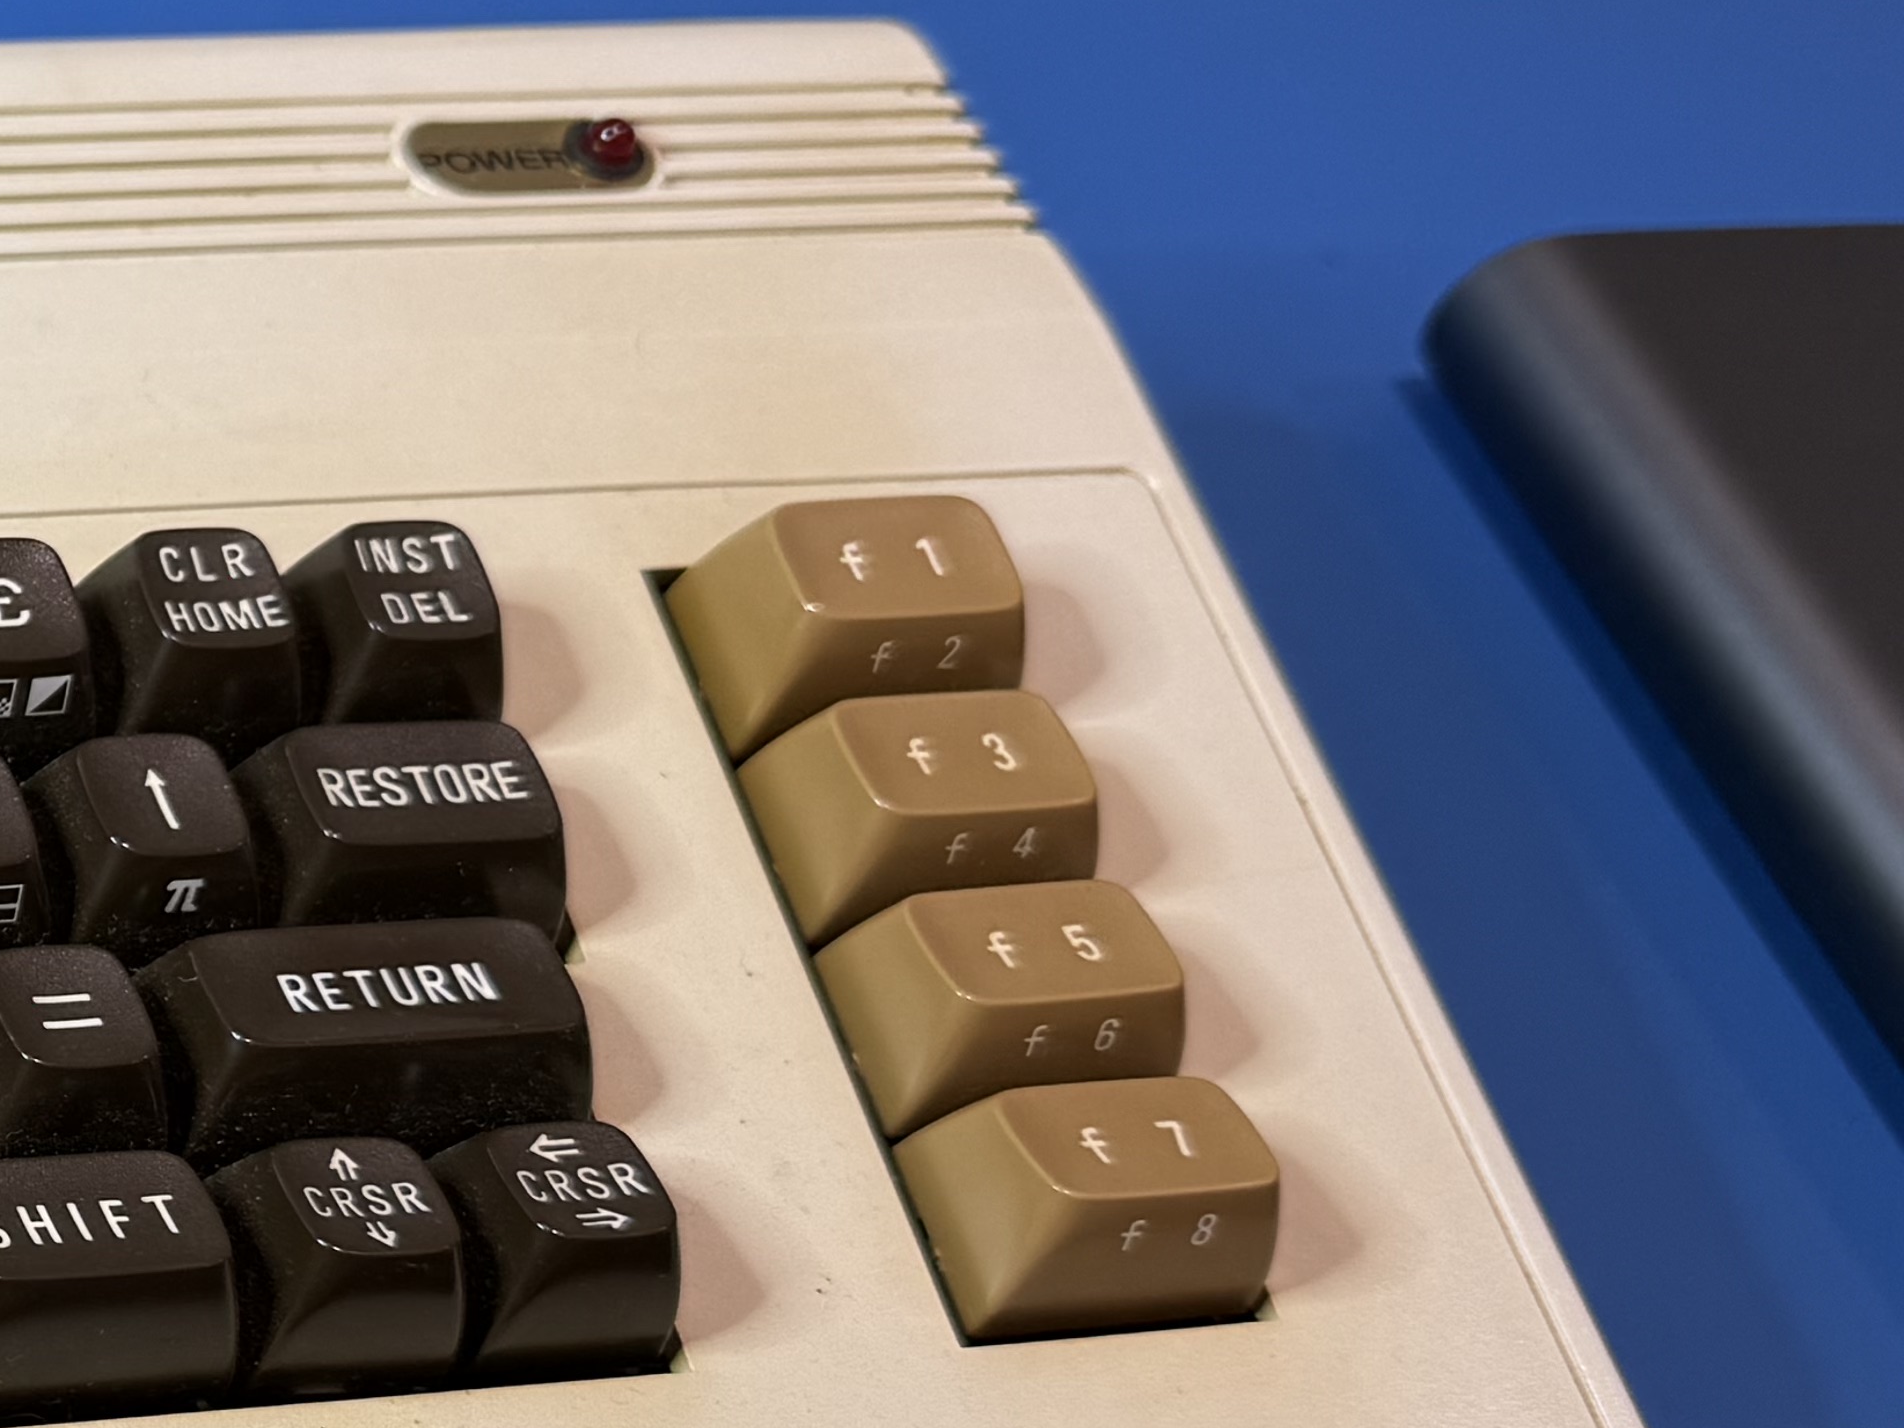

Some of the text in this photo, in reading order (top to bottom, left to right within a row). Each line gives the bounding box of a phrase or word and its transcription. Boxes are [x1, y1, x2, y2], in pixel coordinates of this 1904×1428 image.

[418, 149, 566, 174] POWER
[159, 542, 255, 582] CLR
[350, 532, 460, 574] INST
[164, 594, 289, 632] HOME
[380, 591, 470, 624] DEL
[316, 760, 529, 807] RESTORE
[276, 962, 499, 1013] RETURN
[32, 993, 104, 1030] =
[303, 1182, 431, 1217] CRSR
[514, 1162, 649, 1204] CRSR
